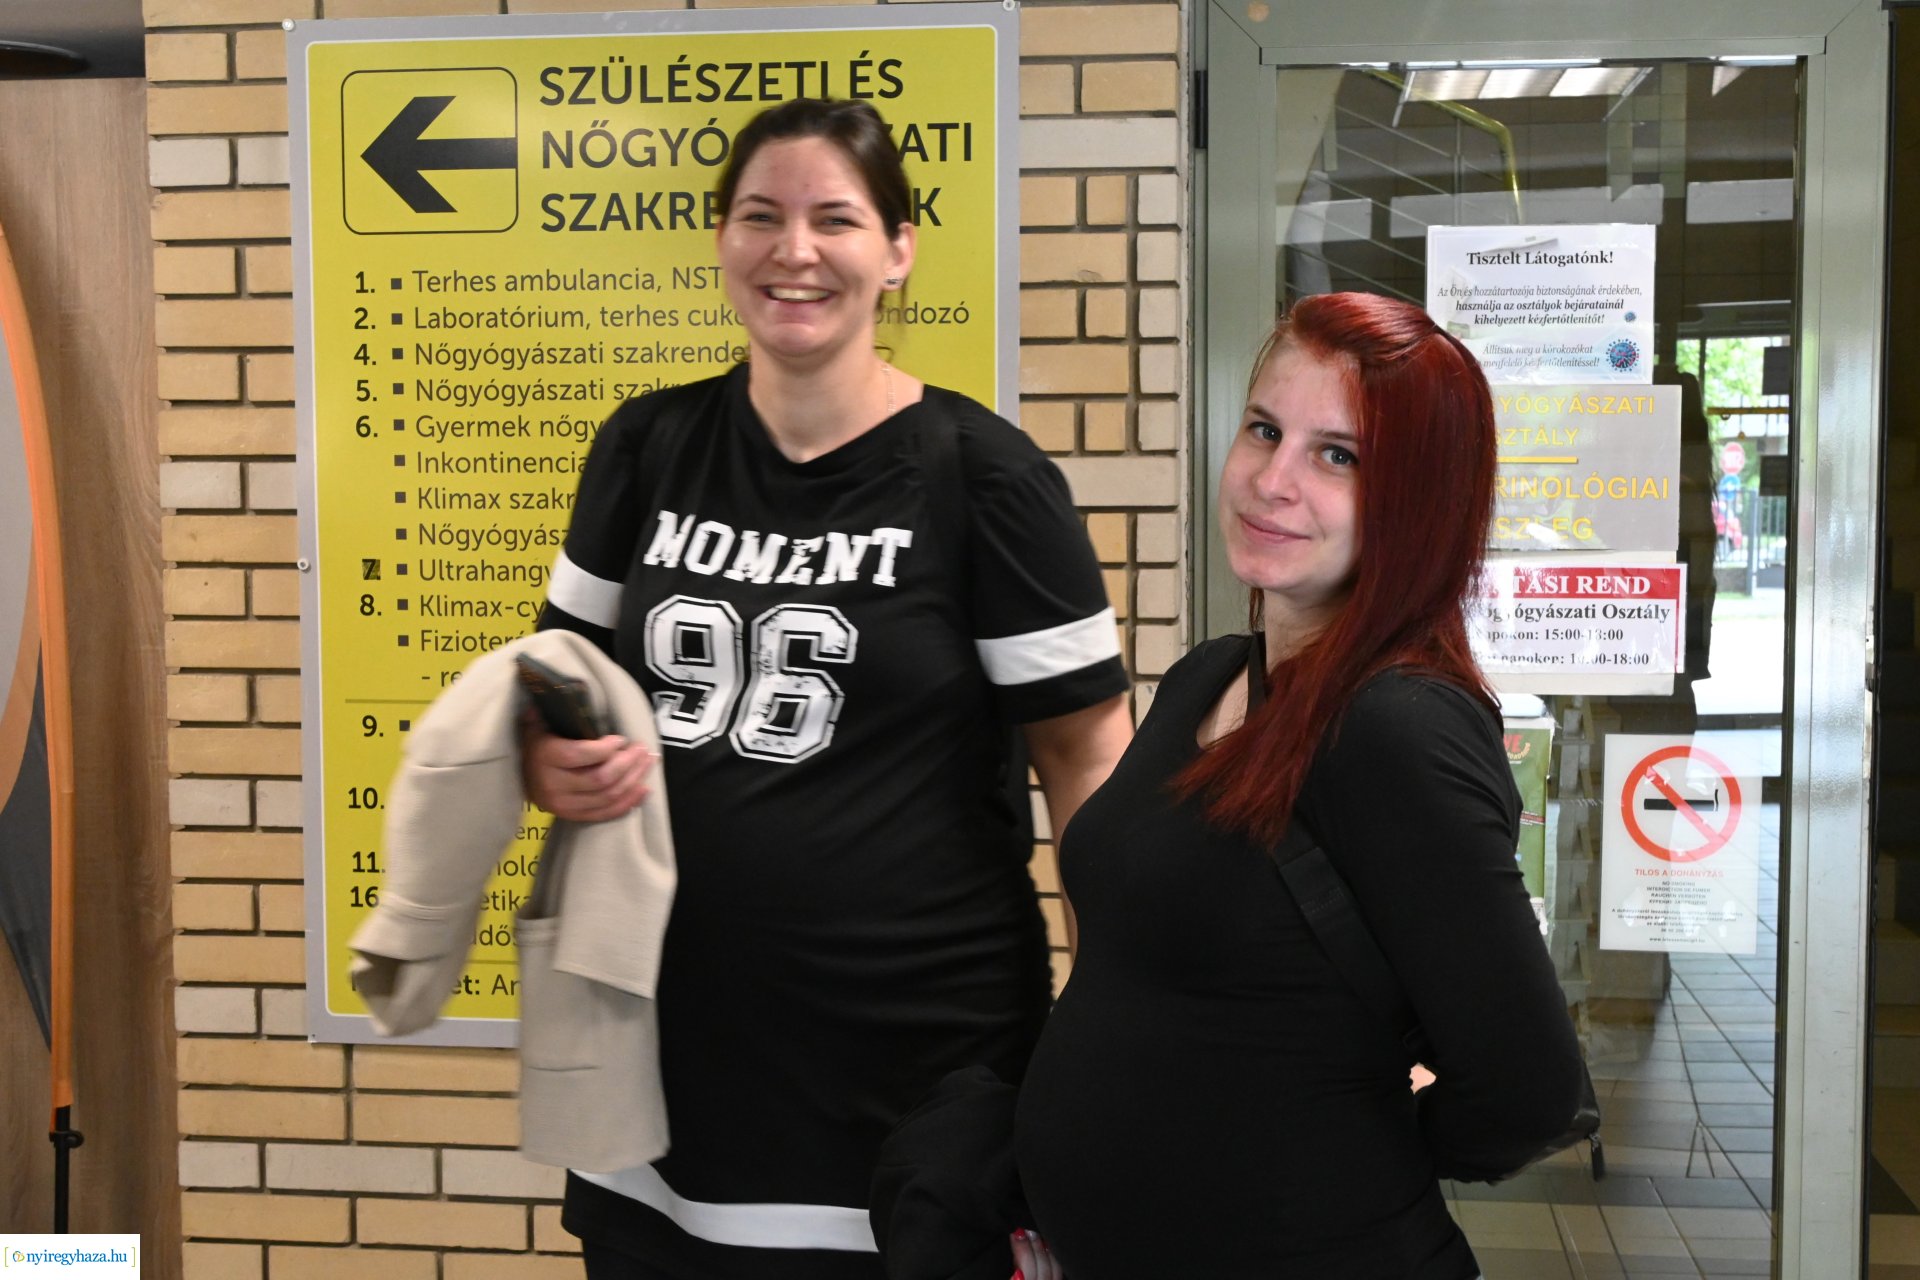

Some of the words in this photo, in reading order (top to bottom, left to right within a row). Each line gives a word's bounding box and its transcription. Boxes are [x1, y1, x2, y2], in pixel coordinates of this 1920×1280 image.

[540, 54, 829, 106] SZÜLÉSZETI
[849, 50, 904, 99] ÉS
[1466, 251, 1521, 265] Tisztelt
[1525, 250, 1613, 267] Látogatónk!
[355, 271, 375, 294] 1.
[412, 269, 496, 293] Terhes
[504, 268, 662, 293] ambulancia,
[672, 266, 723, 290] NST
[1437, 287, 1448, 297] Az
[1474, 285, 1534, 298] hozzátartozója
[1536, 285, 1595, 298] biztonságának
[1598, 284, 1642, 296] érdekében,
[354, 307, 376, 330] 2.
[415, 304, 591, 330] Laboratórium,
[600, 303, 679, 327] terhes
[1456, 300, 1501, 312] használja
[1517, 299, 1562, 312] osztályok
[1564, 299, 1624, 312] bejáratainál
[1474, 314, 1526, 327] kihelyezett
[1528, 313, 1605, 326] kézfertőtlenítőt!
[354, 343, 377, 366] 4.
[415, 341, 604, 371] Nőgyógyászati
[356, 379, 377, 402] 5.
[416, 377, 605, 408] Nőgyógyászati
[1494, 392, 1655, 414] YÓGYÁSZATI
[355, 415, 378, 438] 6.
[416, 415, 531, 443] Gyermek
[418, 487, 501, 510] Klimax
[1495, 516, 1594, 540] SZEG
[643, 509, 913, 587] MOMENT
[1575, 575, 1651, 594] REND
[360, 594, 382, 616] 8.
[1602, 604, 1671, 623] Osztály
[644, 594, 860, 764] 96
[362, 715, 384, 737] 9.
[348, 787, 385, 809] 10.
[352, 851, 386, 873] 11.
